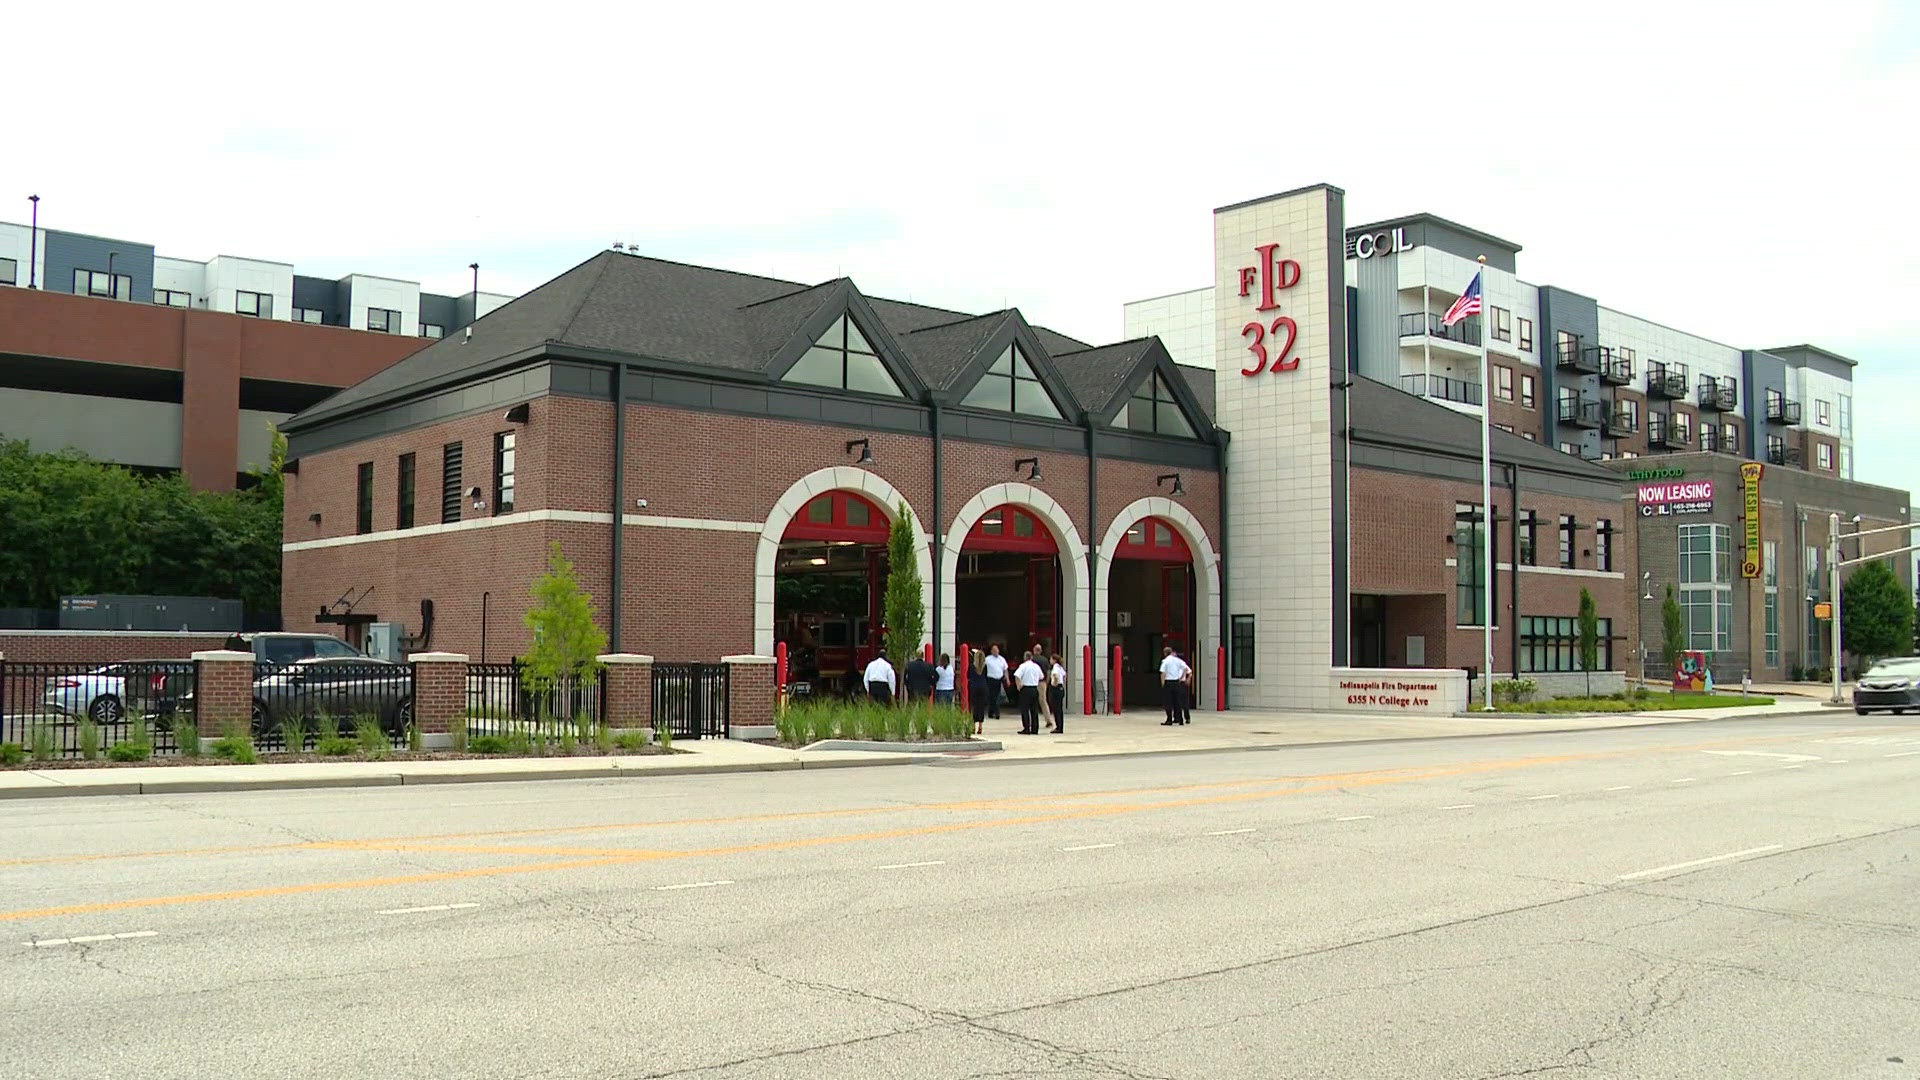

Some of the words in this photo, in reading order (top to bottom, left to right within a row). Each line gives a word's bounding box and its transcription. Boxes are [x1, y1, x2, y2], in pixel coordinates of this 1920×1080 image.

[1356, 228, 1414, 259] COIL
[1241, 316, 1300, 377] 32
[1655, 467, 1684, 479] FOOD
[1639, 486, 1665, 502] NOW
[1666, 483, 1711, 500] LEASING
[1746, 480, 1757, 512] FRESH
[1642, 504, 1669, 516] COIL
[1747, 518, 1758, 551] THYME
[1340, 681, 1379, 691] Indianapolis
[1381, 682, 1395, 690] Fire
[1397, 682, 1437, 692] Department
[1369, 695, 1376, 704] N
[1379, 695, 1410, 707] College
[1412, 696, 1428, 706] Ave
